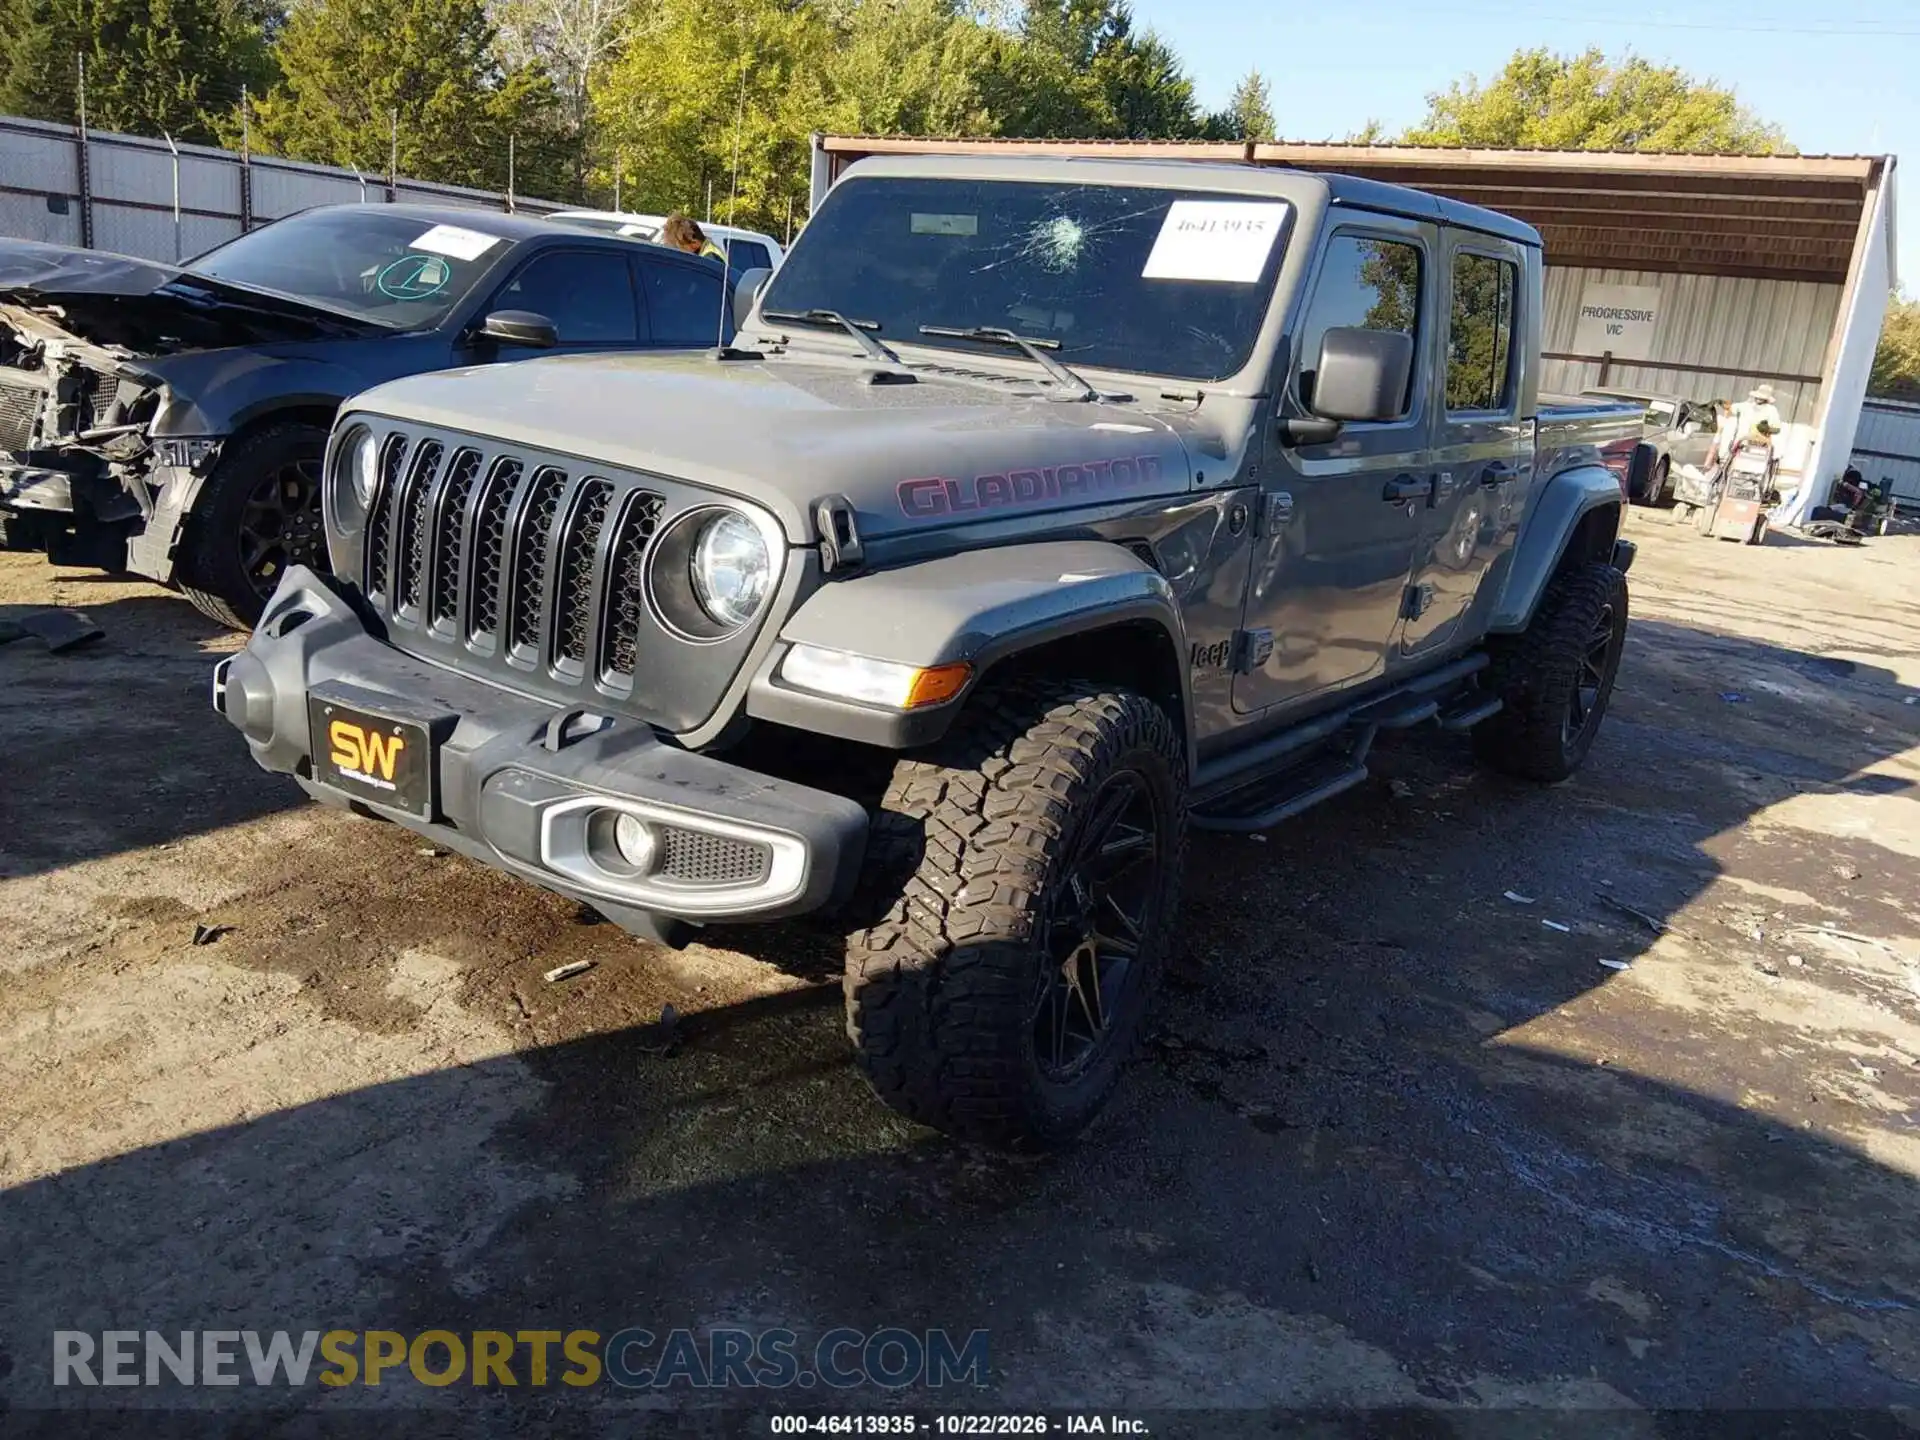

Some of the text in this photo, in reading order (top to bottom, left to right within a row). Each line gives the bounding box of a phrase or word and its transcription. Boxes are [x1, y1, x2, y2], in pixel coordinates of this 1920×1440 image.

[1582, 306, 1654, 321] PROGRESSIVE
[1606, 324, 1624, 335] VIC
[896, 455, 1162, 518] GLADIATOR
[1190, 640, 1229, 668] Jeep
[330, 720, 405, 781] SW
